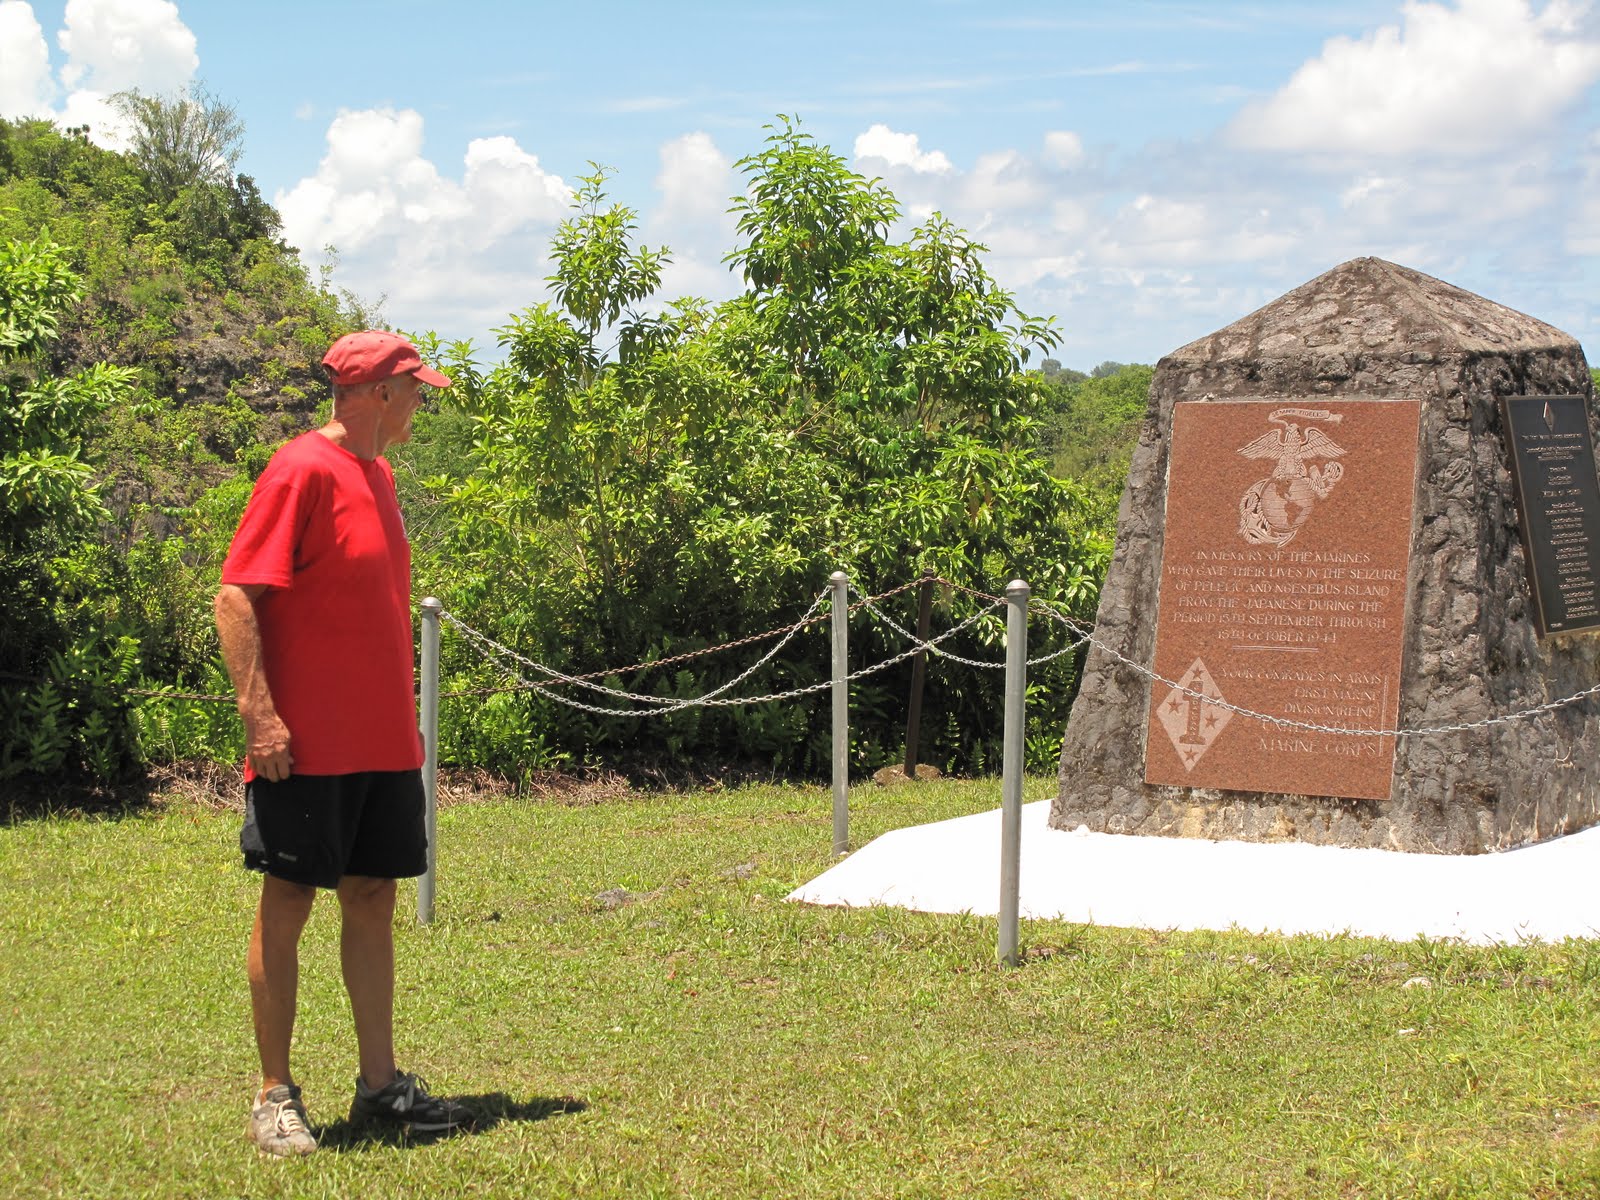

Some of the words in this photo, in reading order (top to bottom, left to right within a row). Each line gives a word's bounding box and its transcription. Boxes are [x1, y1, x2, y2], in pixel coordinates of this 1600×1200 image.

[1196, 551, 1208, 560] IN
[1269, 551, 1283, 562] OF
[1289, 551, 1312, 562] THE
[1316, 552, 1370, 563] MARINES
[1167, 565, 1194, 575] WHO
[1197, 565, 1229, 576] GAVE
[1233, 567, 1266, 577] THEIR
[1270, 567, 1302, 578] LIVES
[1306, 568, 1318, 578] IN
[1323, 568, 1345, 579] THE
[1349, 569, 1402, 581] SEIZURE
[1175, 581, 1190, 591] OF
[1246, 582, 1272, 593] AND
[1275, 583, 1341, 594] NGESEBUS
[1344, 584, 1390, 596] ISLAND
[1179, 597, 1214, 607] FROM
[1218, 597, 1240, 608] THE
[1243, 598, 1305, 610] JAPANESE
[1309, 599, 1354, 611] DURING
[1359, 601, 1383, 612] THE
[1174, 613, 1216, 623] PERIOD
[1248, 614, 1323, 626] SEPTEMBER
[1329, 616, 1387, 628] THROUGH
[1346, 672, 1381, 685] ARMS
[1259, 738, 1320, 753] MARINE
[1325, 741, 1376, 756] CORPS
